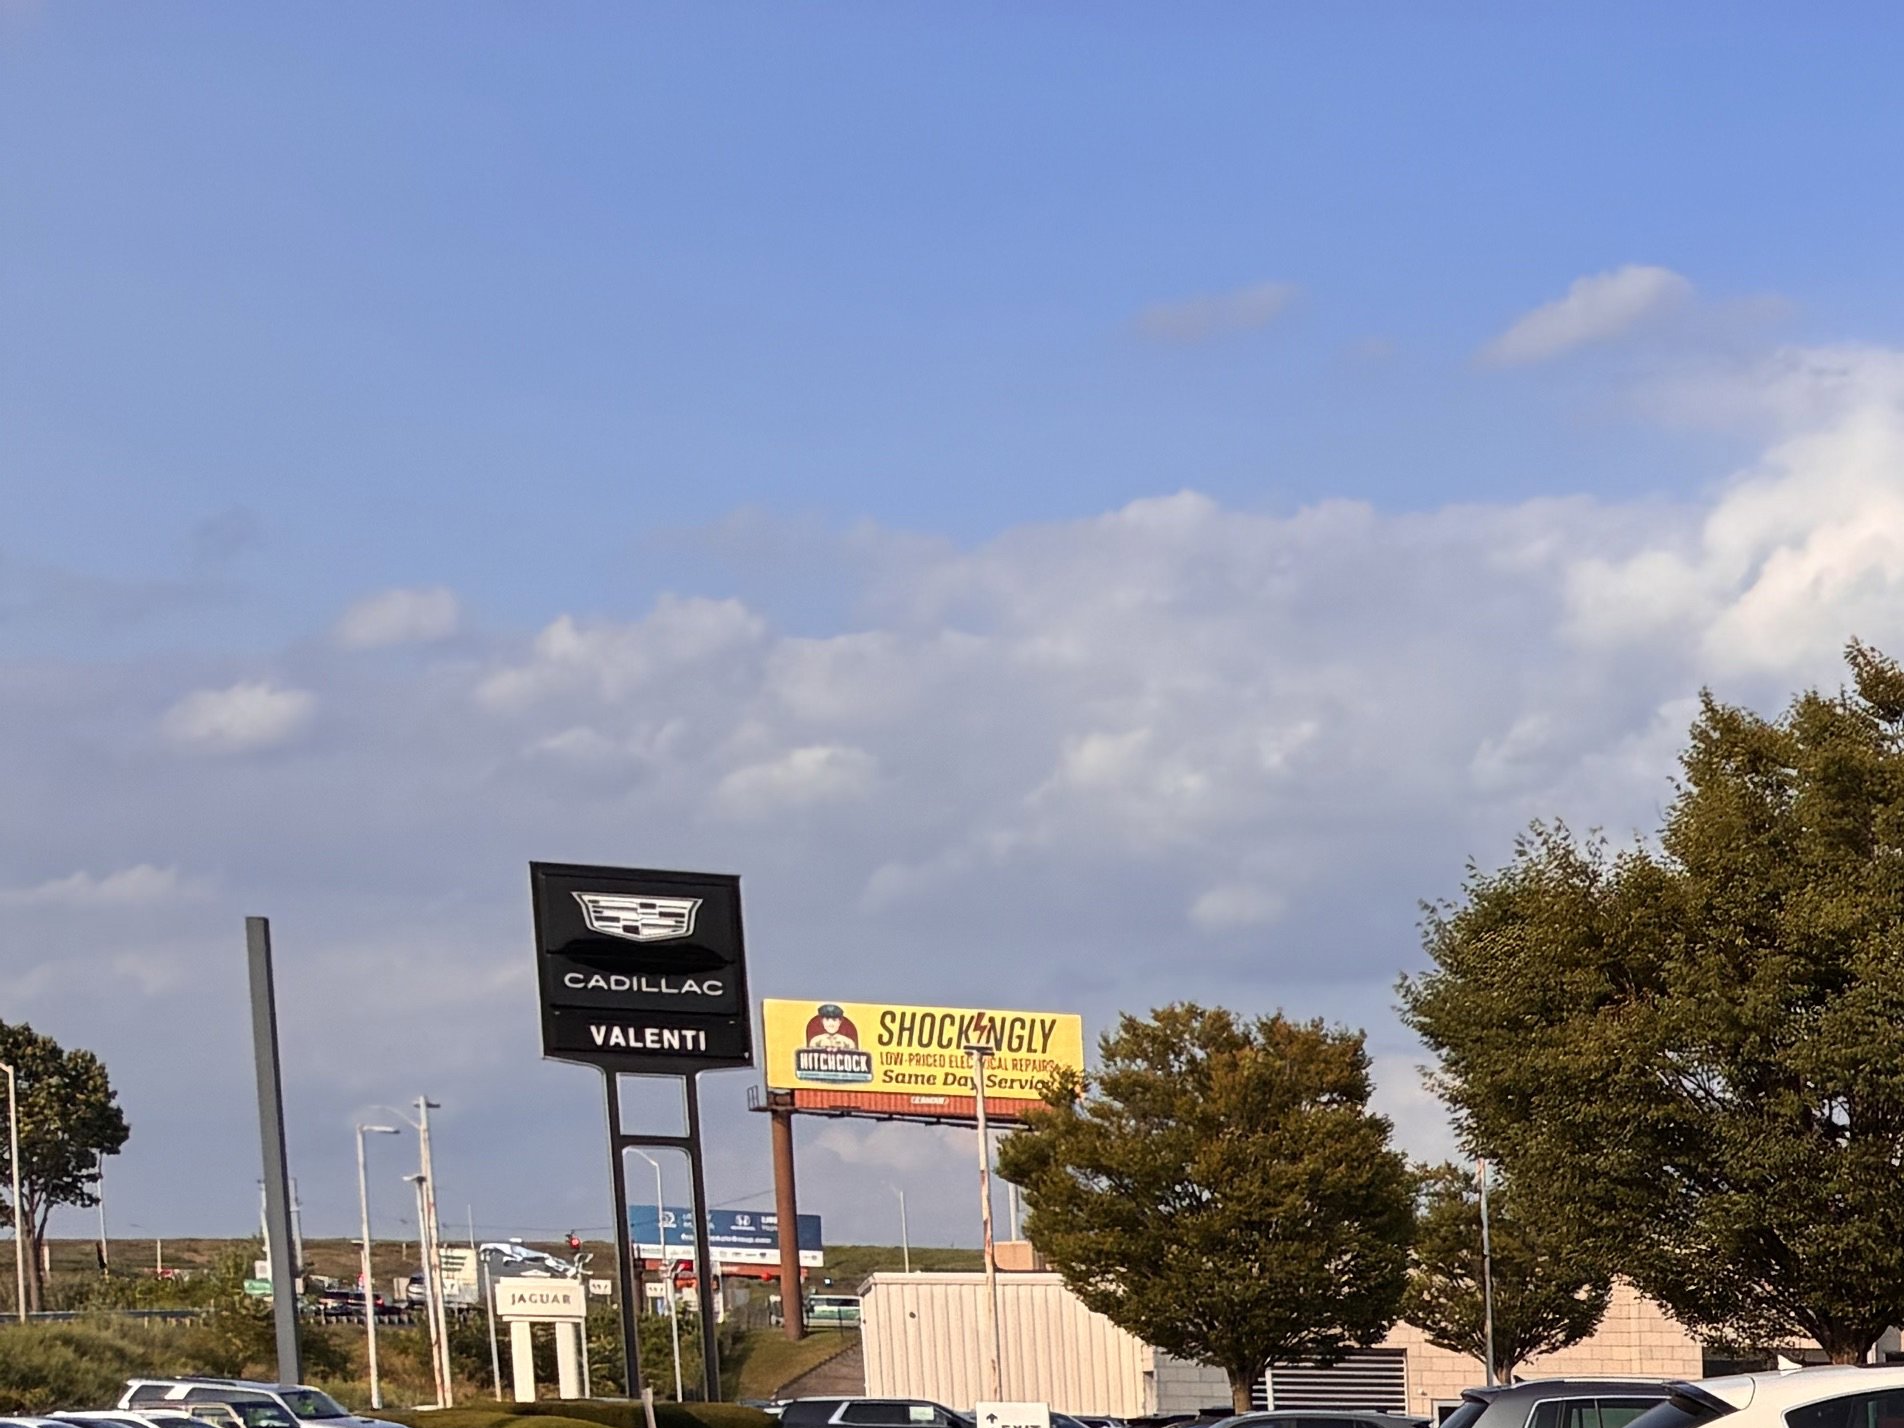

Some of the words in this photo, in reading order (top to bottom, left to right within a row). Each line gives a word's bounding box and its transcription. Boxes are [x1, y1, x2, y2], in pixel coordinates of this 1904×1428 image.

[563, 972, 724, 997] CADILLAC
[589, 1024, 707, 1052] VALENTI
[799, 1052, 869, 1073] HITCHCOCK
[948, 1055, 1009, 1072] ELECICAL
[882, 1069, 937, 1086] Same
[942, 1072, 978, 1091] Day
[511, 1293, 572, 1306] JAGUAR
